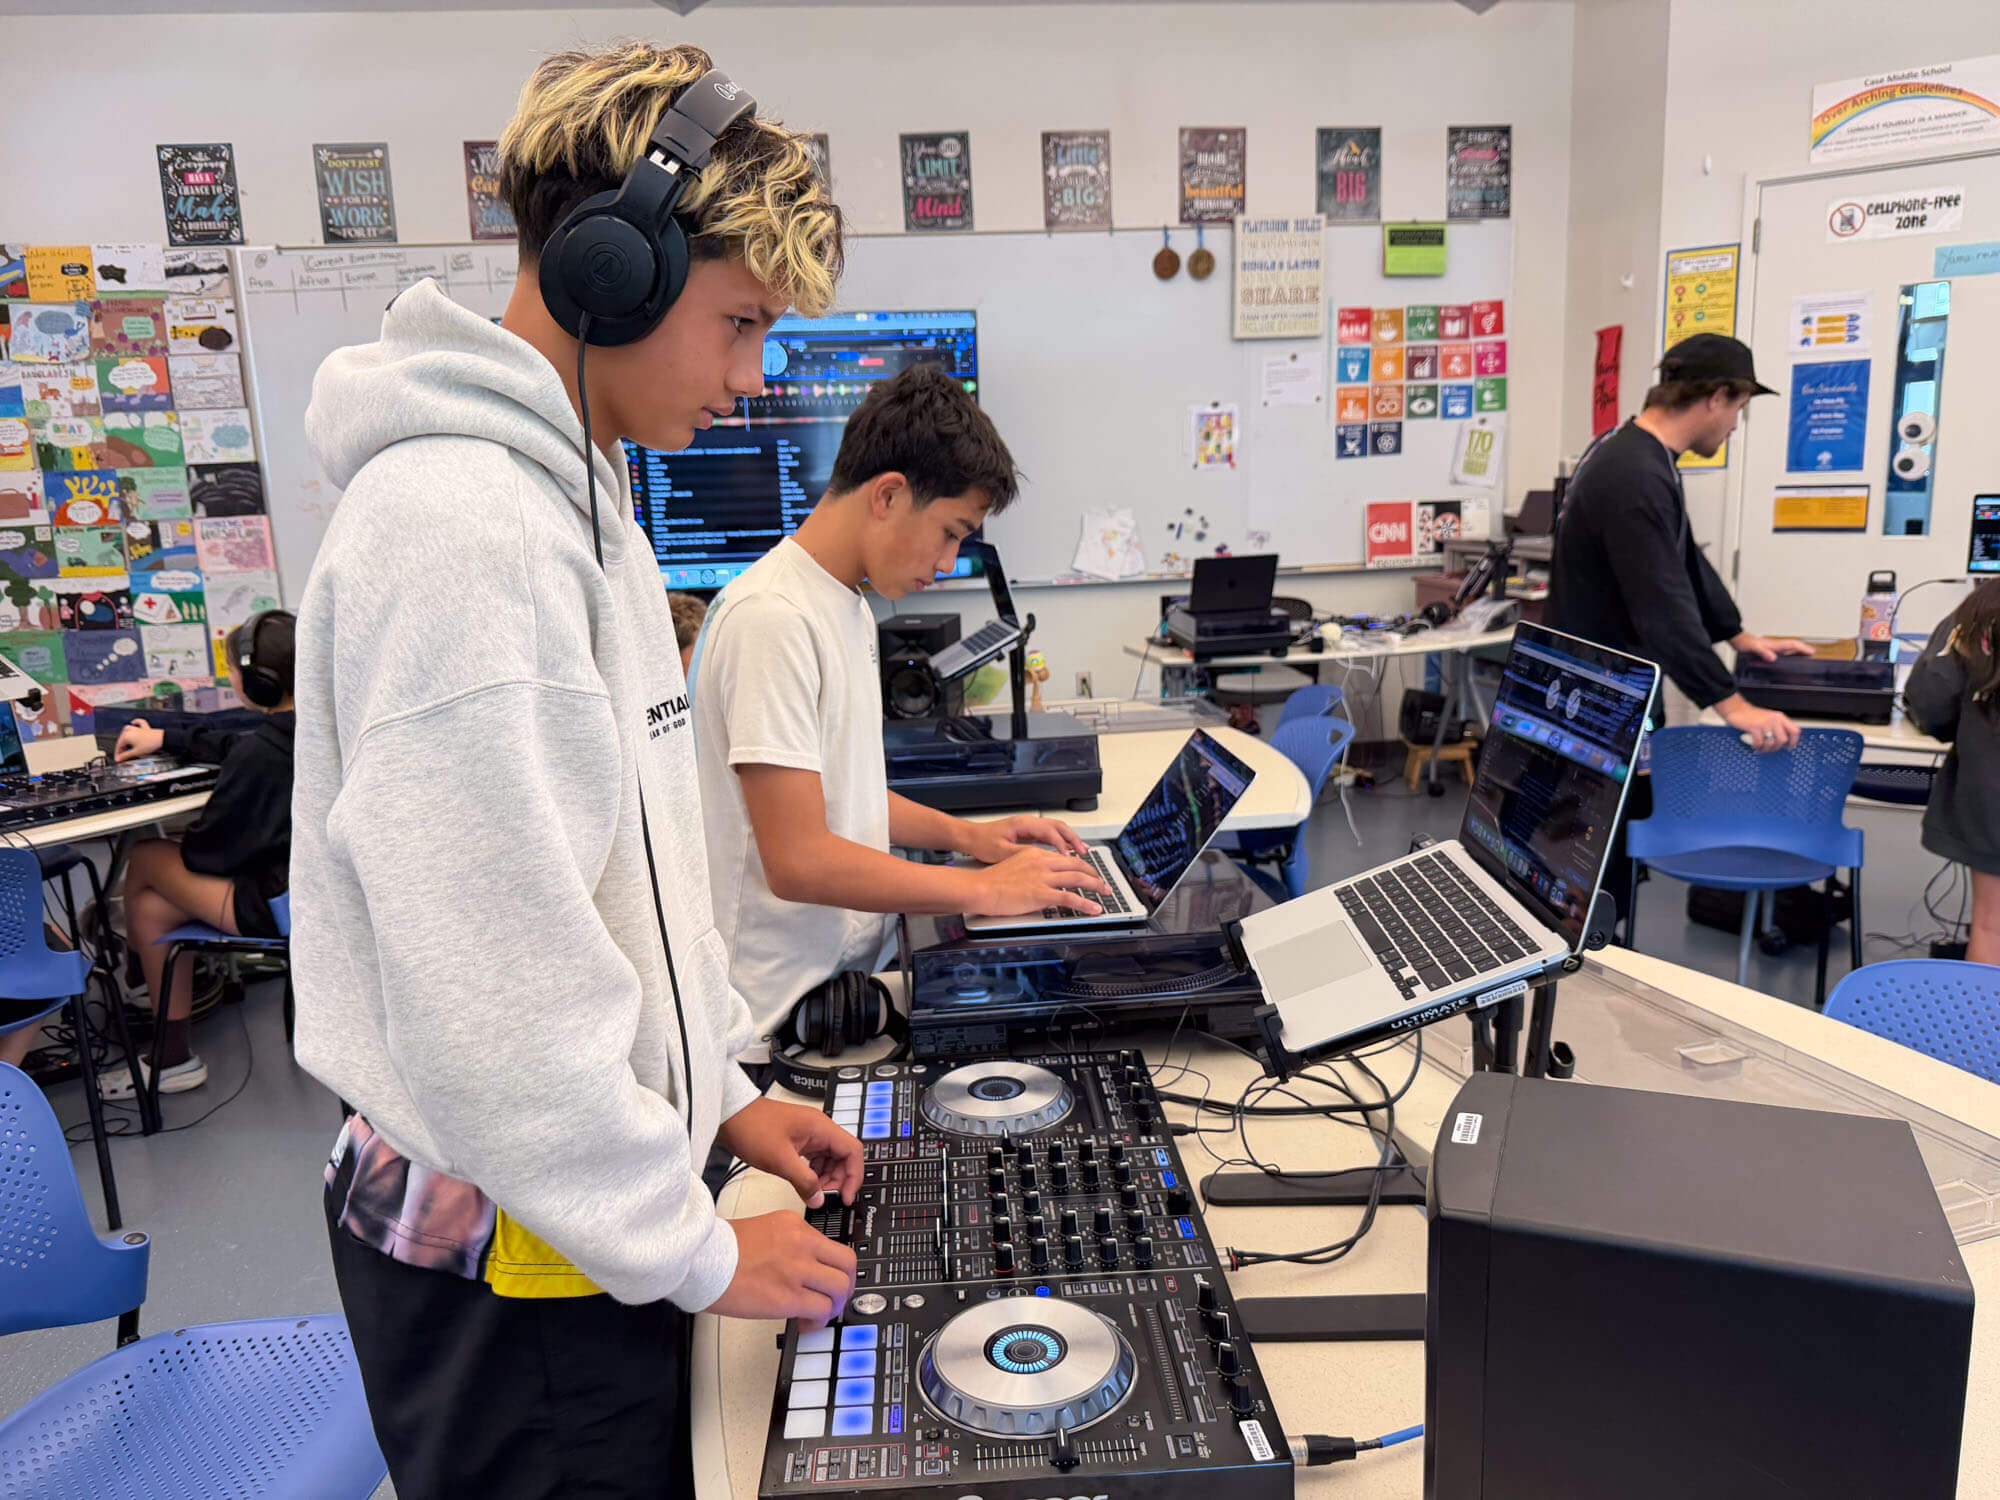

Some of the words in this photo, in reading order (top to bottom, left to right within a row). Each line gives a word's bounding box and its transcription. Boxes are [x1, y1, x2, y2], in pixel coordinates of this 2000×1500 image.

[1864, 77, 1885, 87] Case
[1887, 72, 1919, 82] Middle
[1921, 64, 1952, 77] School
[1821, 105, 1848, 125] Over
[1852, 88, 1897, 108] Arching
[1899, 83, 1964, 96] Guidelines
[328, 159, 357, 168] DON'T
[359, 159, 380, 168] JUST
[1057, 145, 1097, 165] Little
[915, 159, 959, 177] LIMIT
[324, 169, 386, 196] WISH
[1337, 171, 1367, 204] BIG
[910, 195, 963, 219] Mind
[1063, 187, 1096, 206] BIG
[168, 194, 238, 222] Make
[330, 206, 386, 227] WORK
[342, 227, 366, 238] FOR
[367, 226, 378, 238] IT
[299, 275, 330, 287] Africa
[1240, 286, 1321, 306] SHARE
[1368, 521, 1408, 544] CNN
[662, 724, 671, 733] OF
[673, 718, 686, 729] GOD
[1391, 997, 1470, 1029] ULTIMATE
